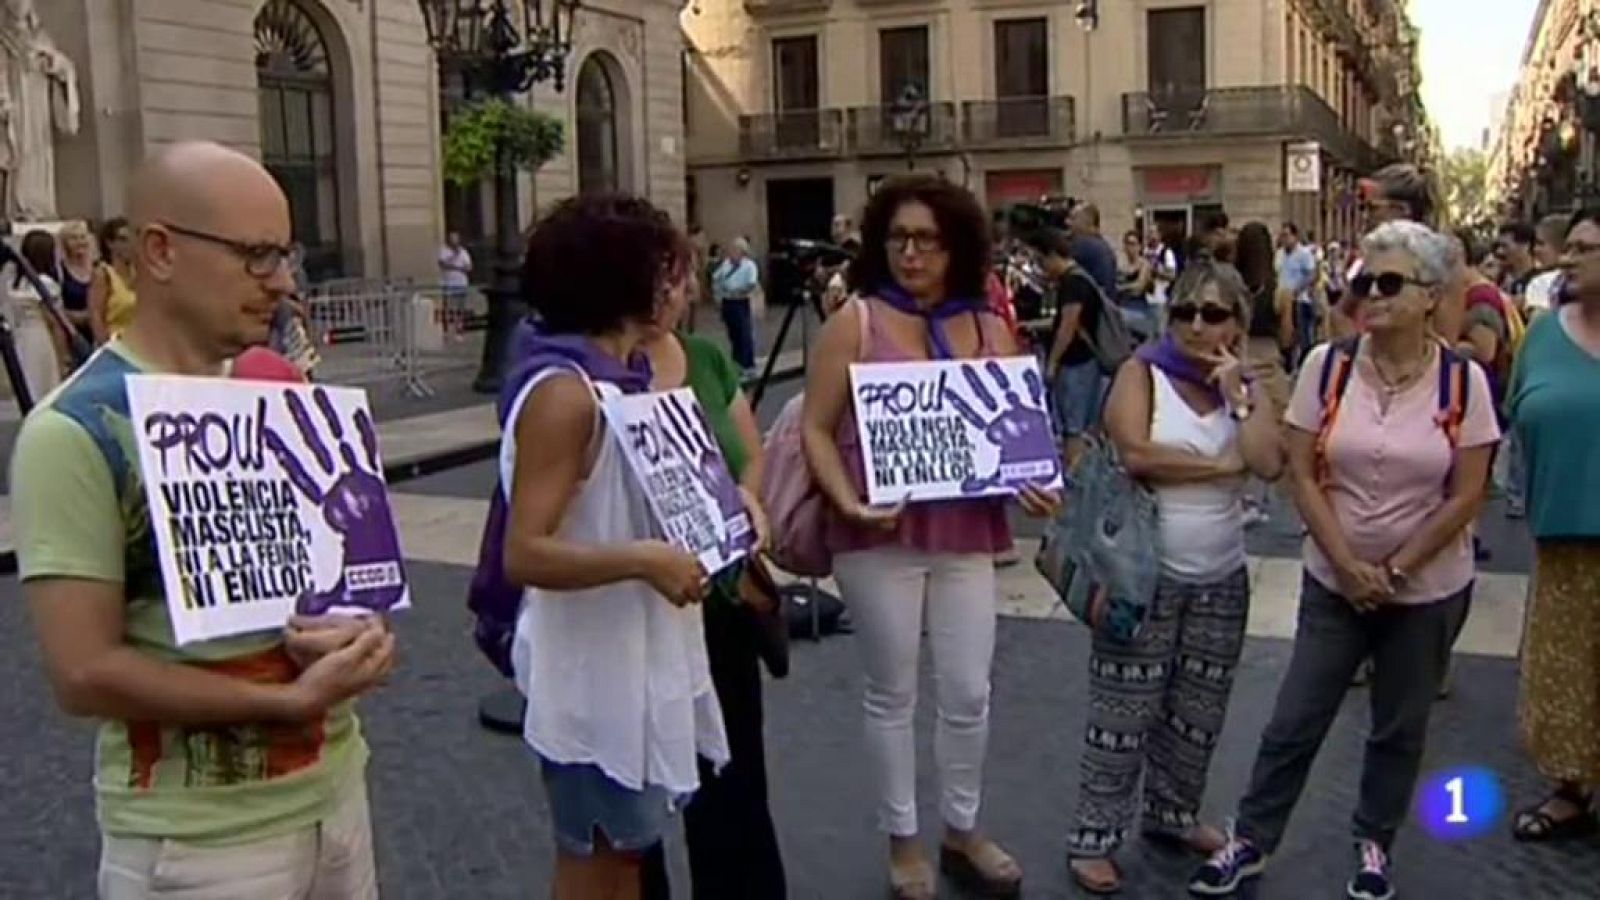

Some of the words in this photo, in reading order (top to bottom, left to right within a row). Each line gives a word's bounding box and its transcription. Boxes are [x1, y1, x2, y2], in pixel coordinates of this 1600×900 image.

[168, 511, 312, 549] MASCLISTA,
[175, 550, 201, 575] NI
[208, 548, 224, 572] A
[228, 545, 254, 569] LA
[182, 573, 216, 610] NI
[223, 563, 315, 604] ENLLOC
